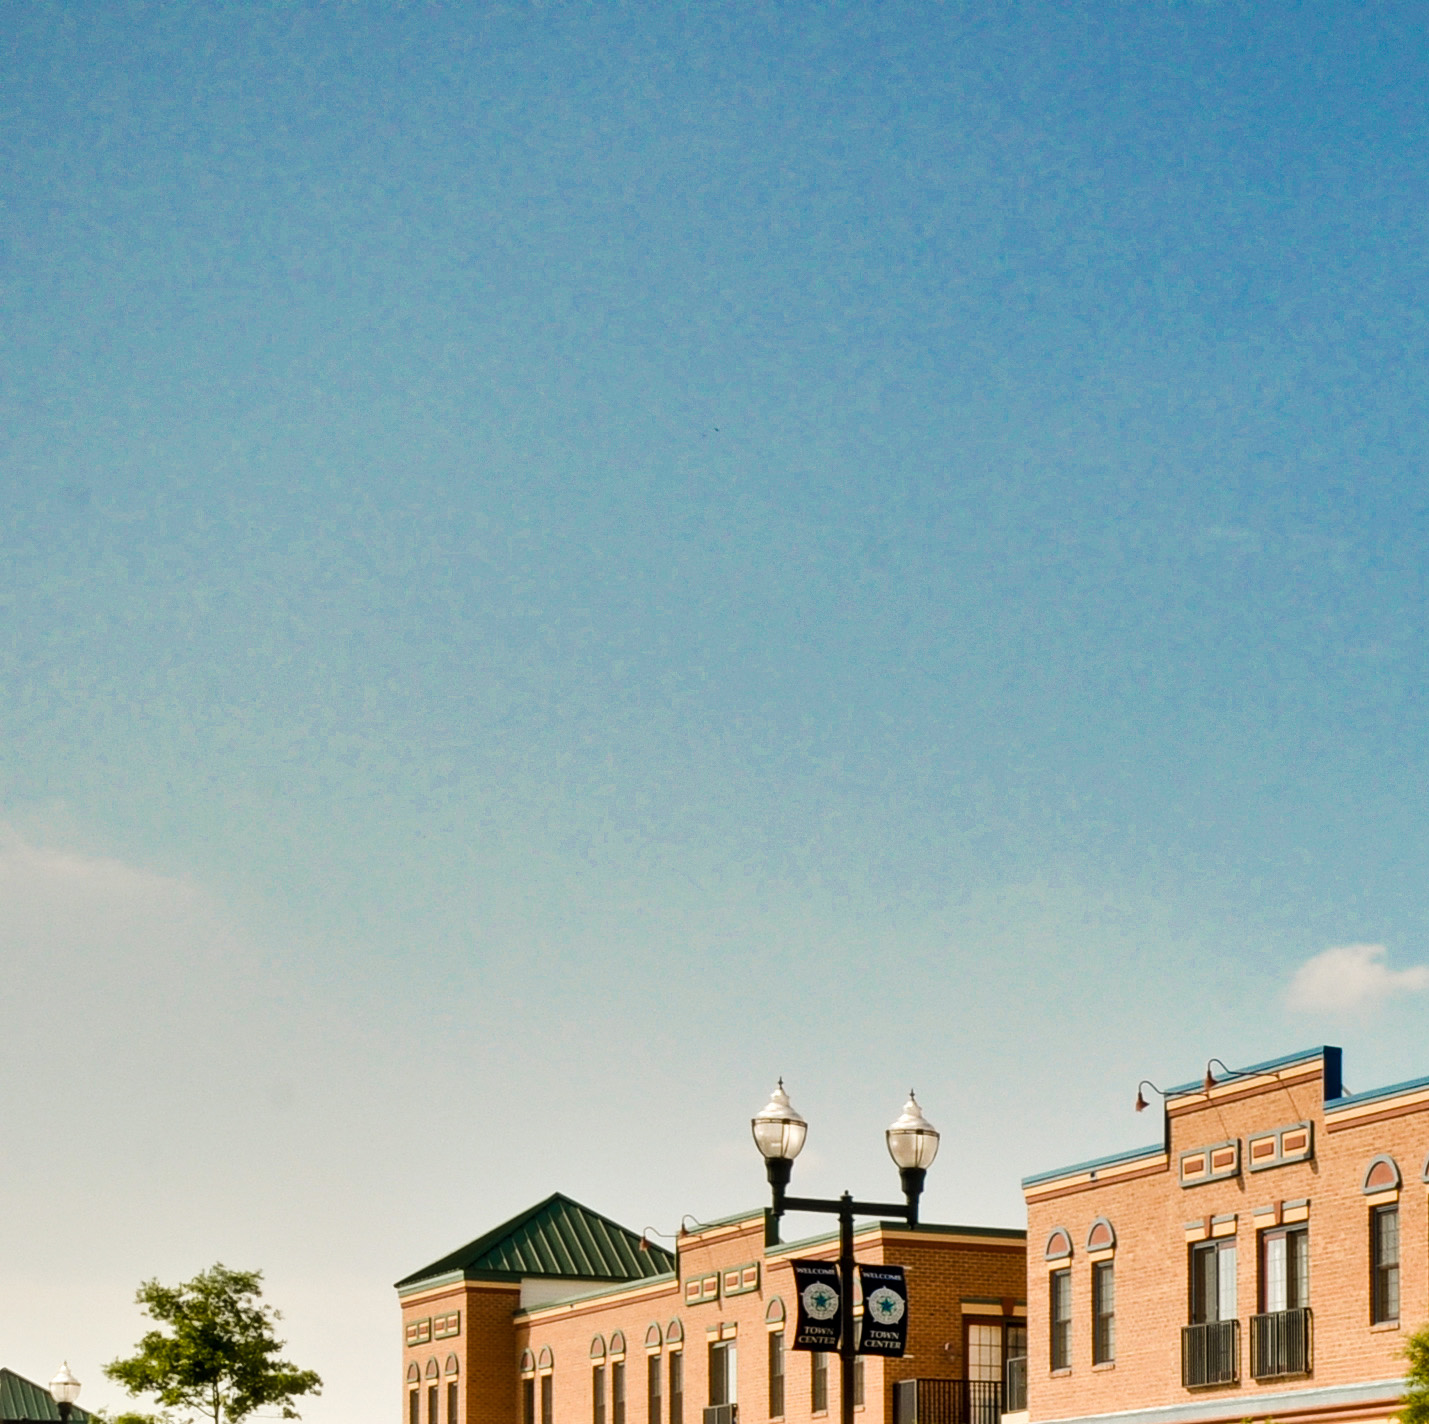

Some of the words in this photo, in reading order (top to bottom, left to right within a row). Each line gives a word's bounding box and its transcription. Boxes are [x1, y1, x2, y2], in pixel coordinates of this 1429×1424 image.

[796, 1267, 835, 1275] WELCOME
[862, 1271, 903, 1281] WELCOME
[804, 1326, 834, 1335] TOWN
[869, 1330, 899, 1339] TOWN
[798, 1336, 835, 1344] CENTER
[864, 1340, 902, 1349] CENTER
